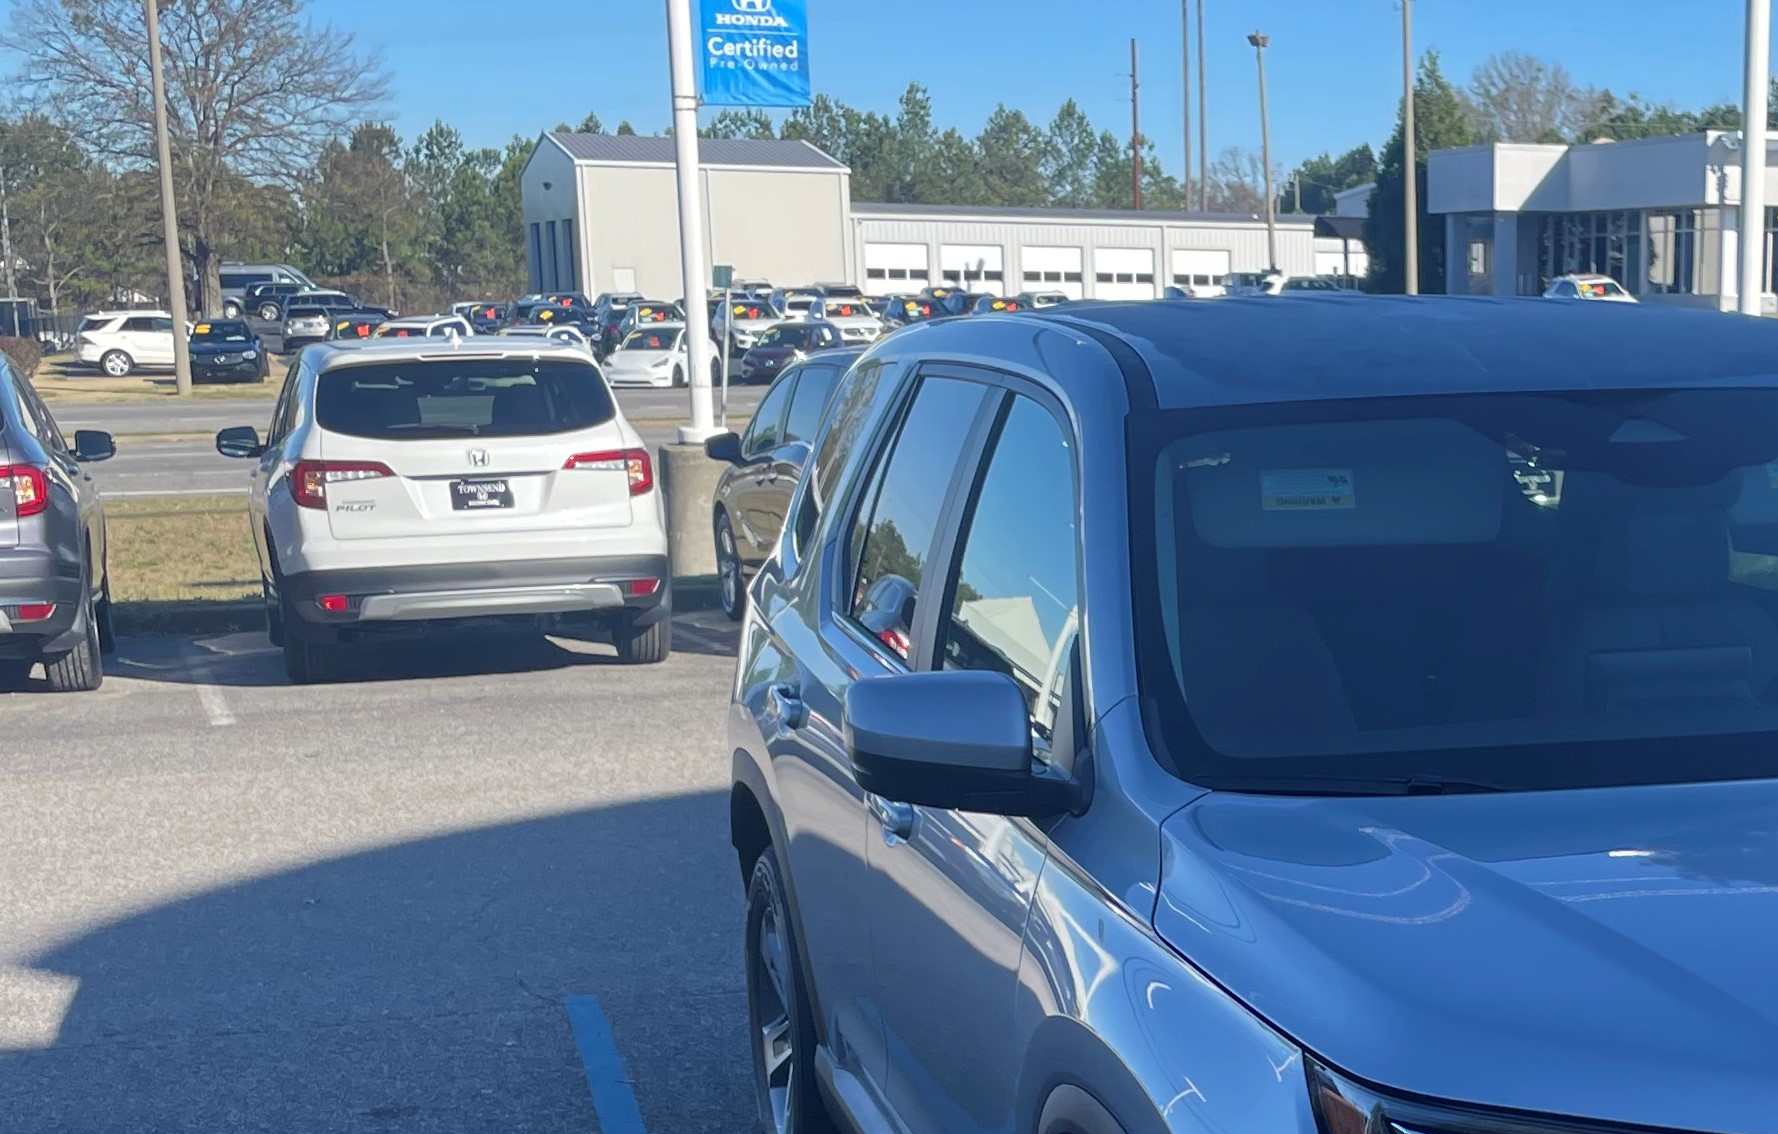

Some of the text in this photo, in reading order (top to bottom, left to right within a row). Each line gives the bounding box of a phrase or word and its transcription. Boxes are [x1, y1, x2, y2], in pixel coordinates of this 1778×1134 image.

[715, 13, 789, 27] HONDA
[707, 36, 798, 58] Certified
[709, 57, 798, 71] Pre-Owned
[457, 482, 506, 494] TOWNSEND
[336, 504, 377, 513] PILOT
